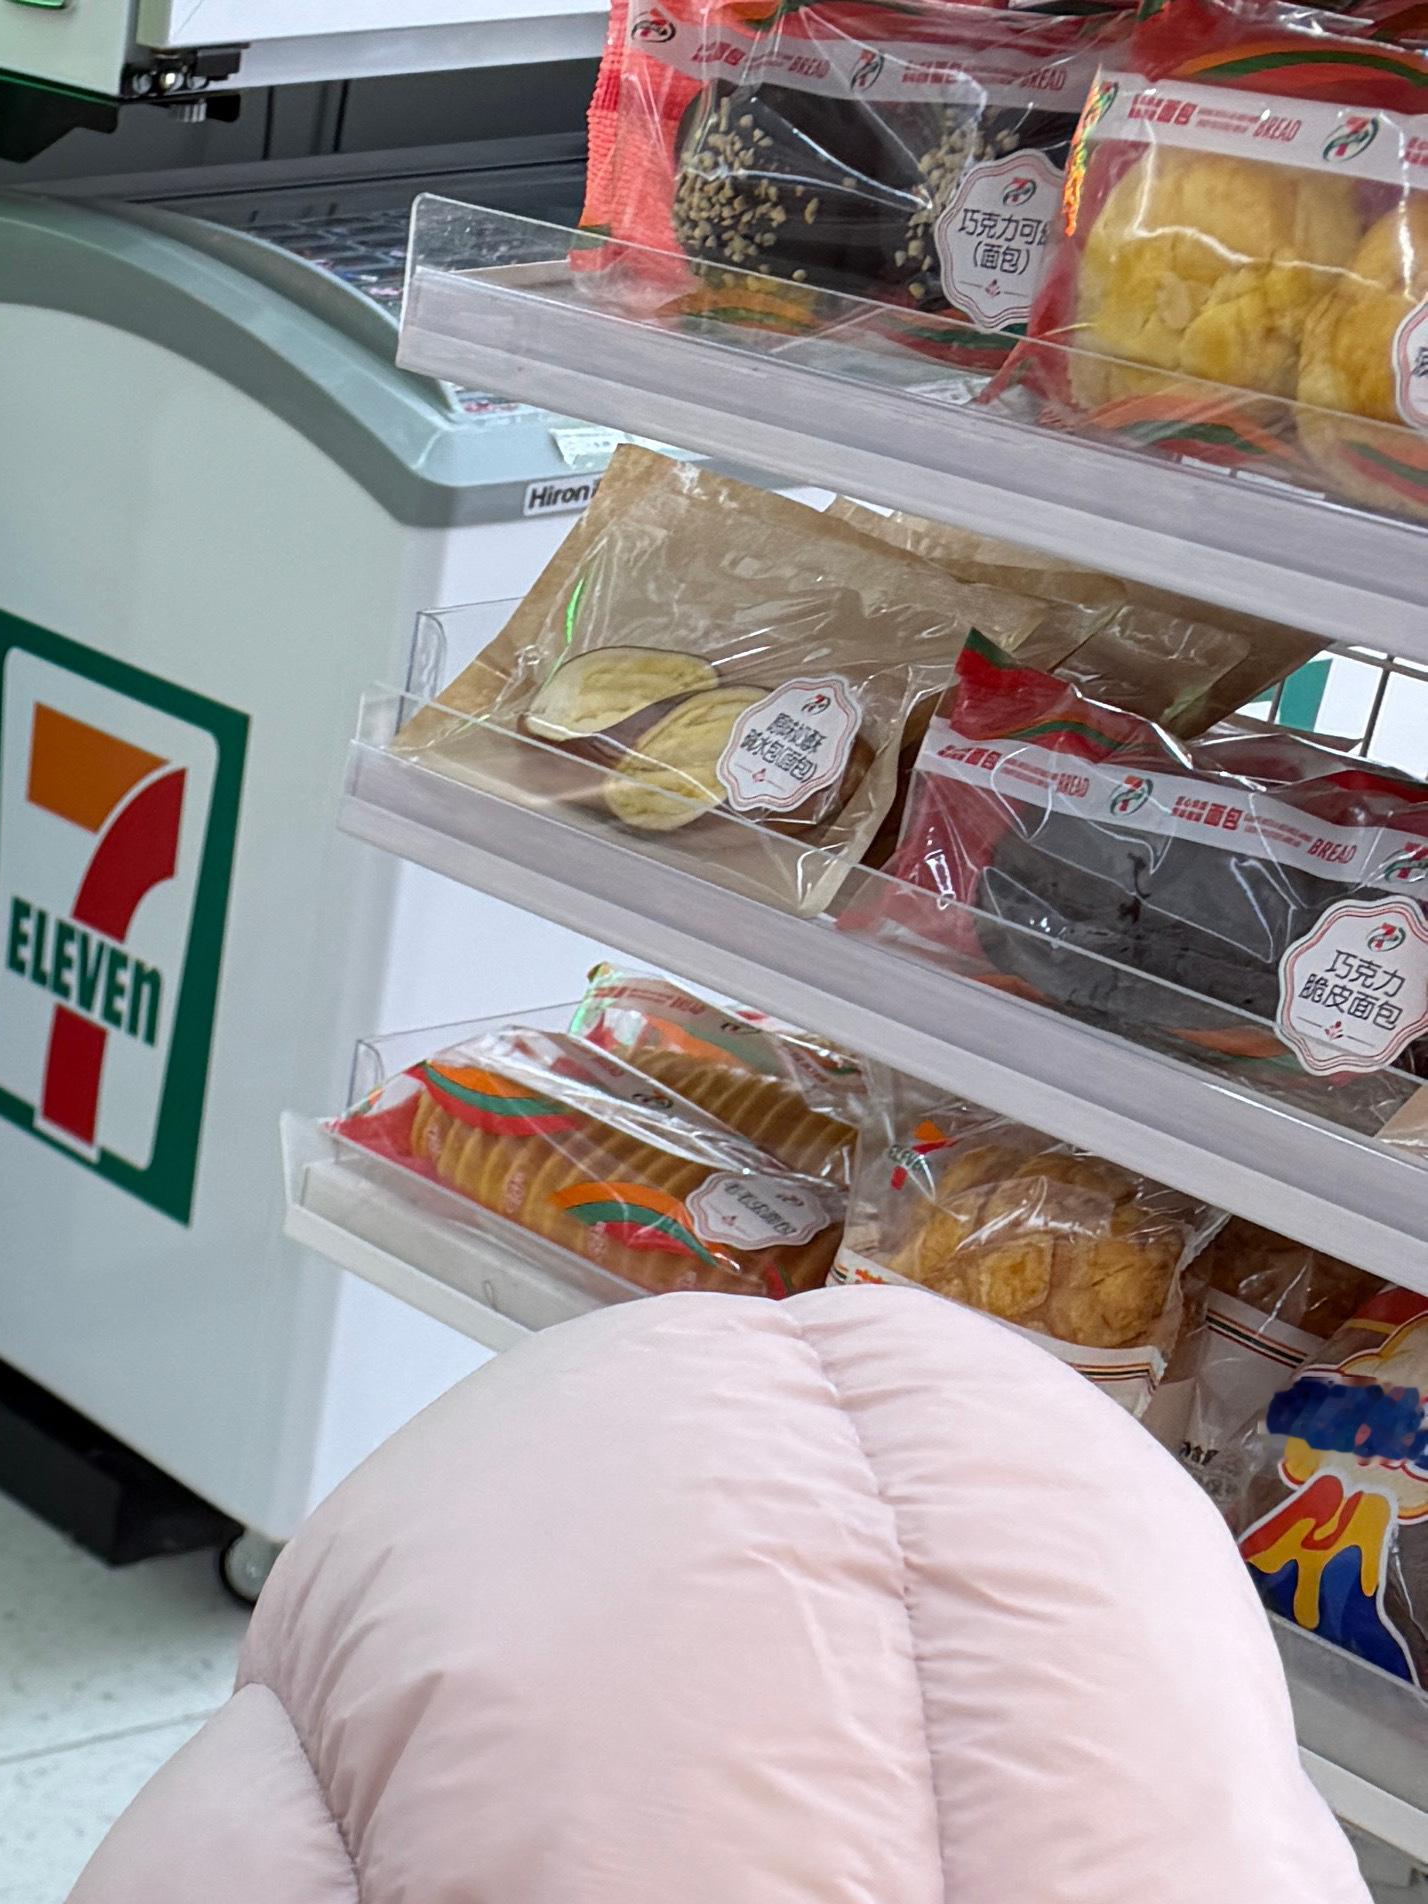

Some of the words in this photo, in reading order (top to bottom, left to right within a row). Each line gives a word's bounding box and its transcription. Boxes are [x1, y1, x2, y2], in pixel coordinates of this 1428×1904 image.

[1307, 837, 1359, 866] BREAD
[1324, 948, 1406, 998] 巧克力
[1297, 972, 1404, 1031] 脆皮面包
